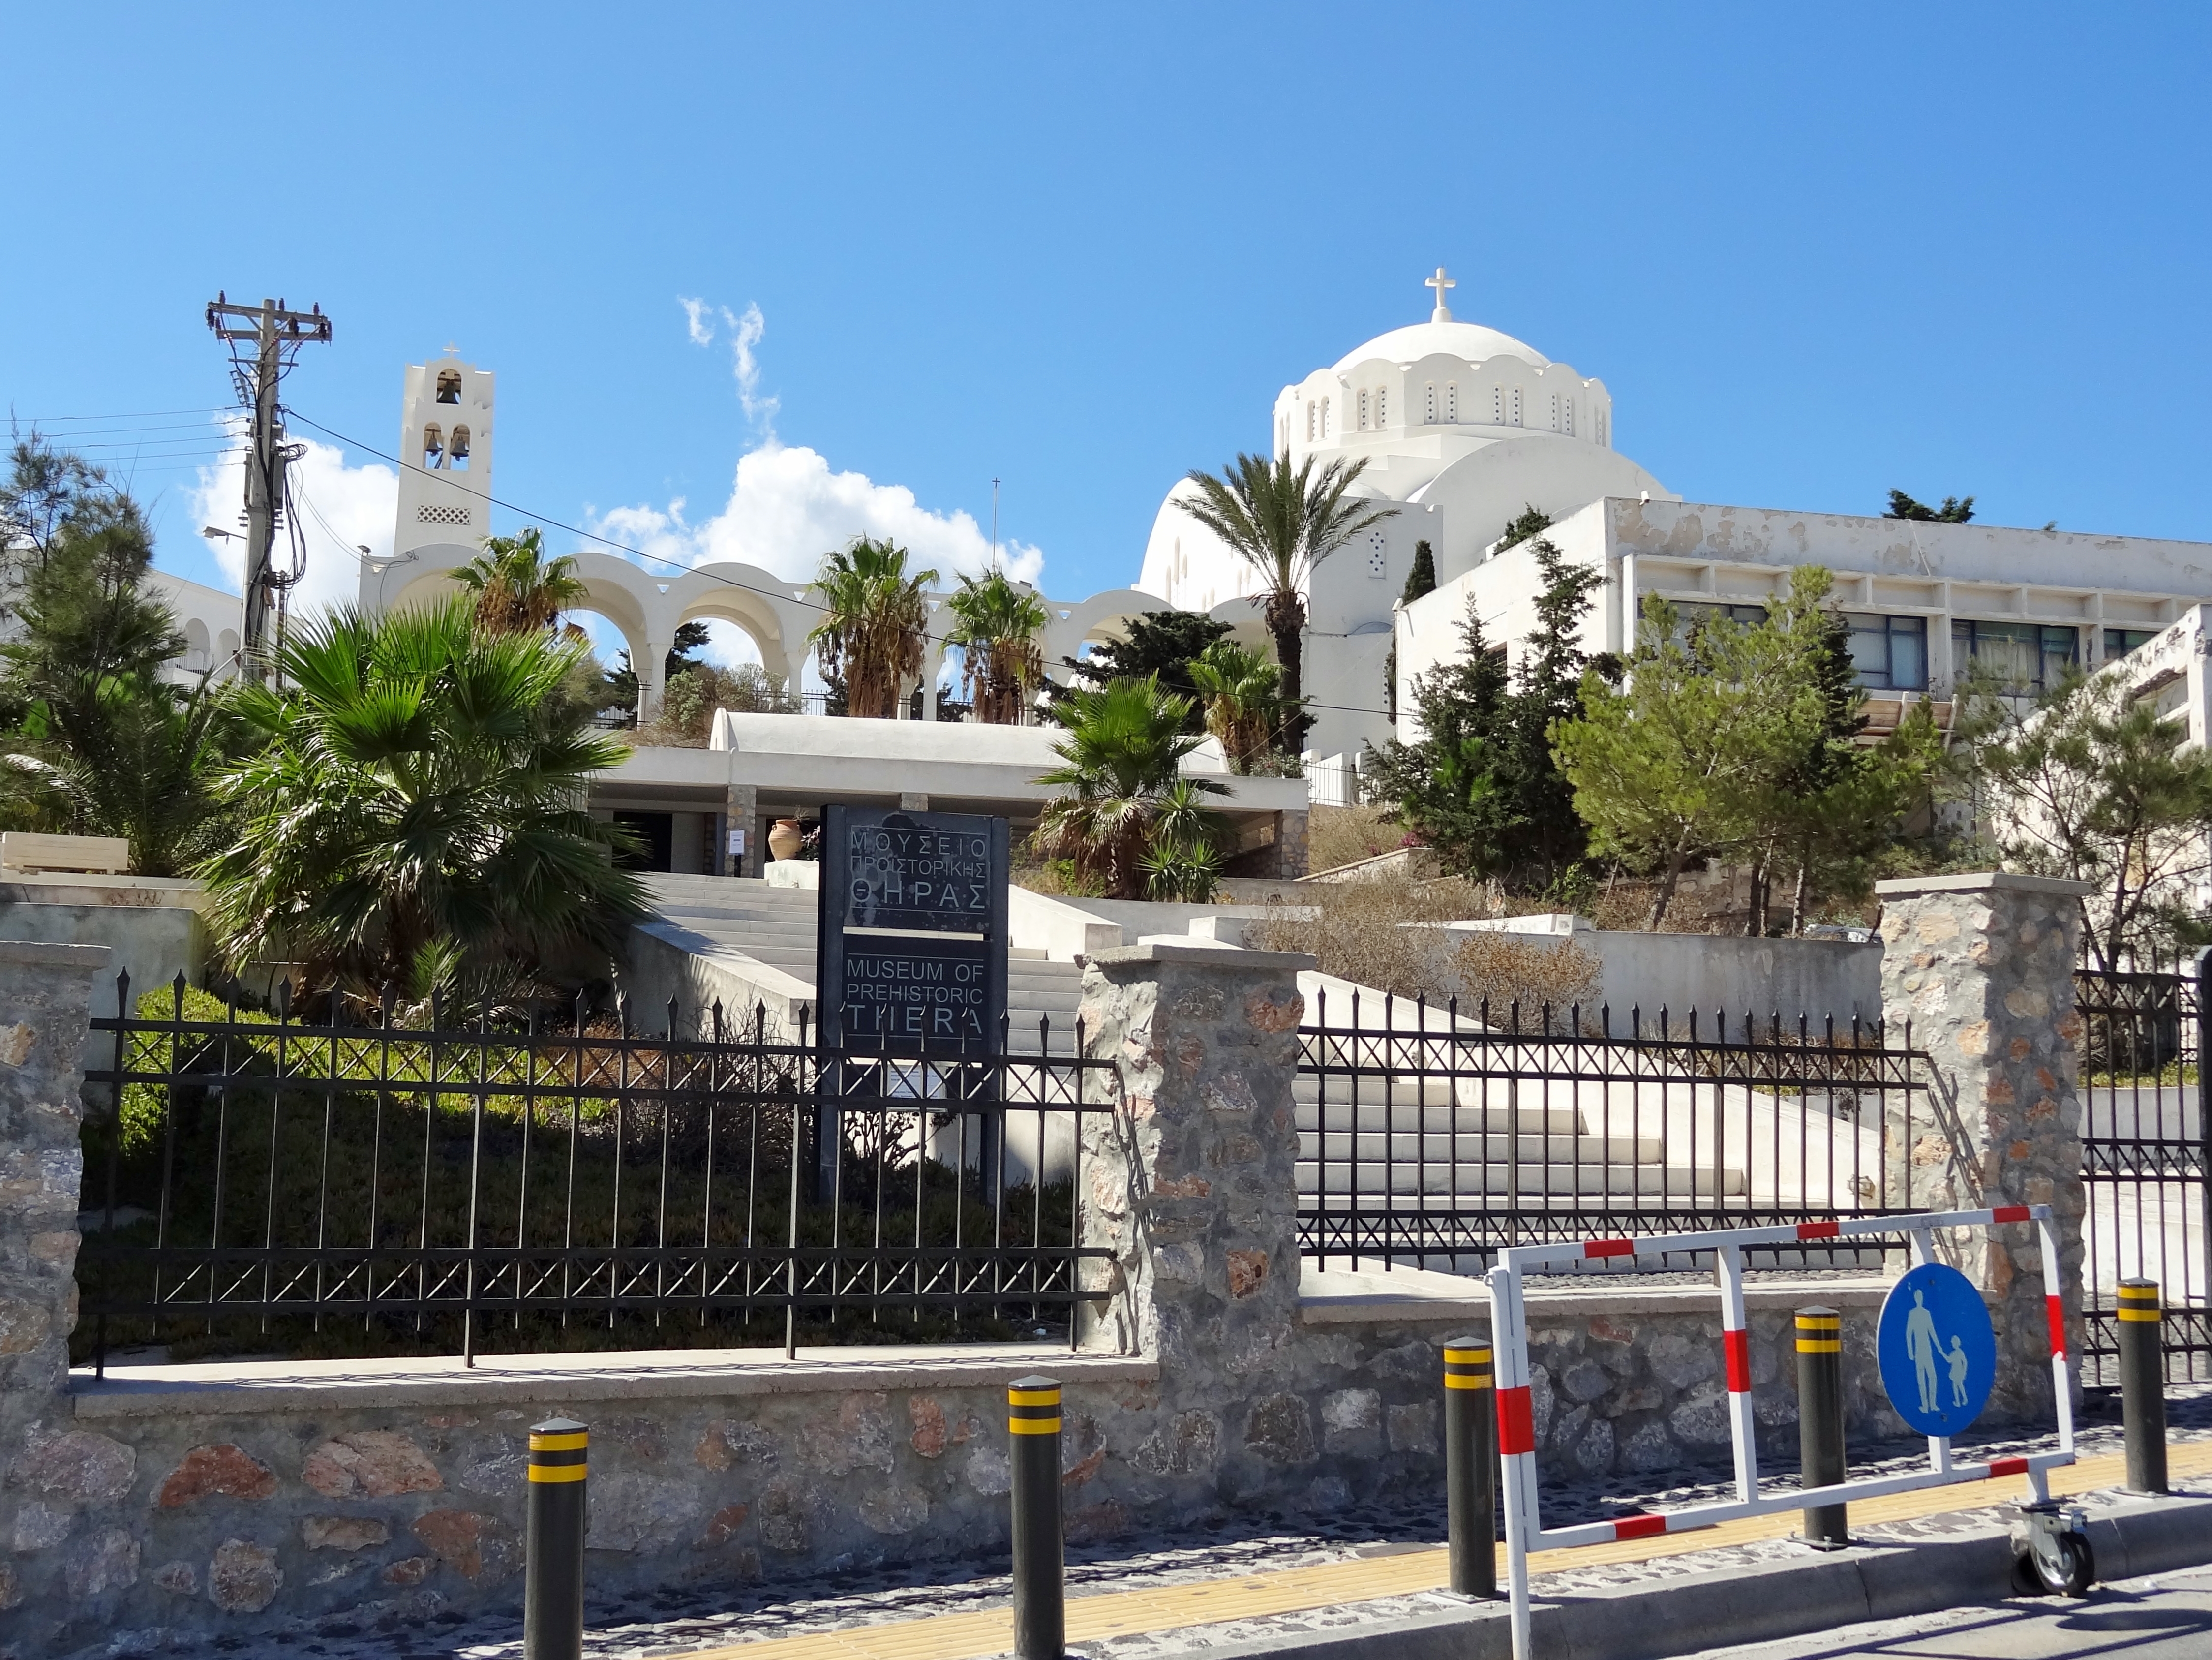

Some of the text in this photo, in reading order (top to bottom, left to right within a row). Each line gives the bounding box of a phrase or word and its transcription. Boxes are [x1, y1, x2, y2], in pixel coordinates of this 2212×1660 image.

[850, 831, 986, 857] ΜΟΥΣΕΙΟ
[851, 878, 985, 909] ΘΗΡΑΣ
[848, 959, 984, 982] MUSEUM OF
[847, 984, 983, 1004] PREHISTORIC
[847, 1004, 982, 1034] THERA
